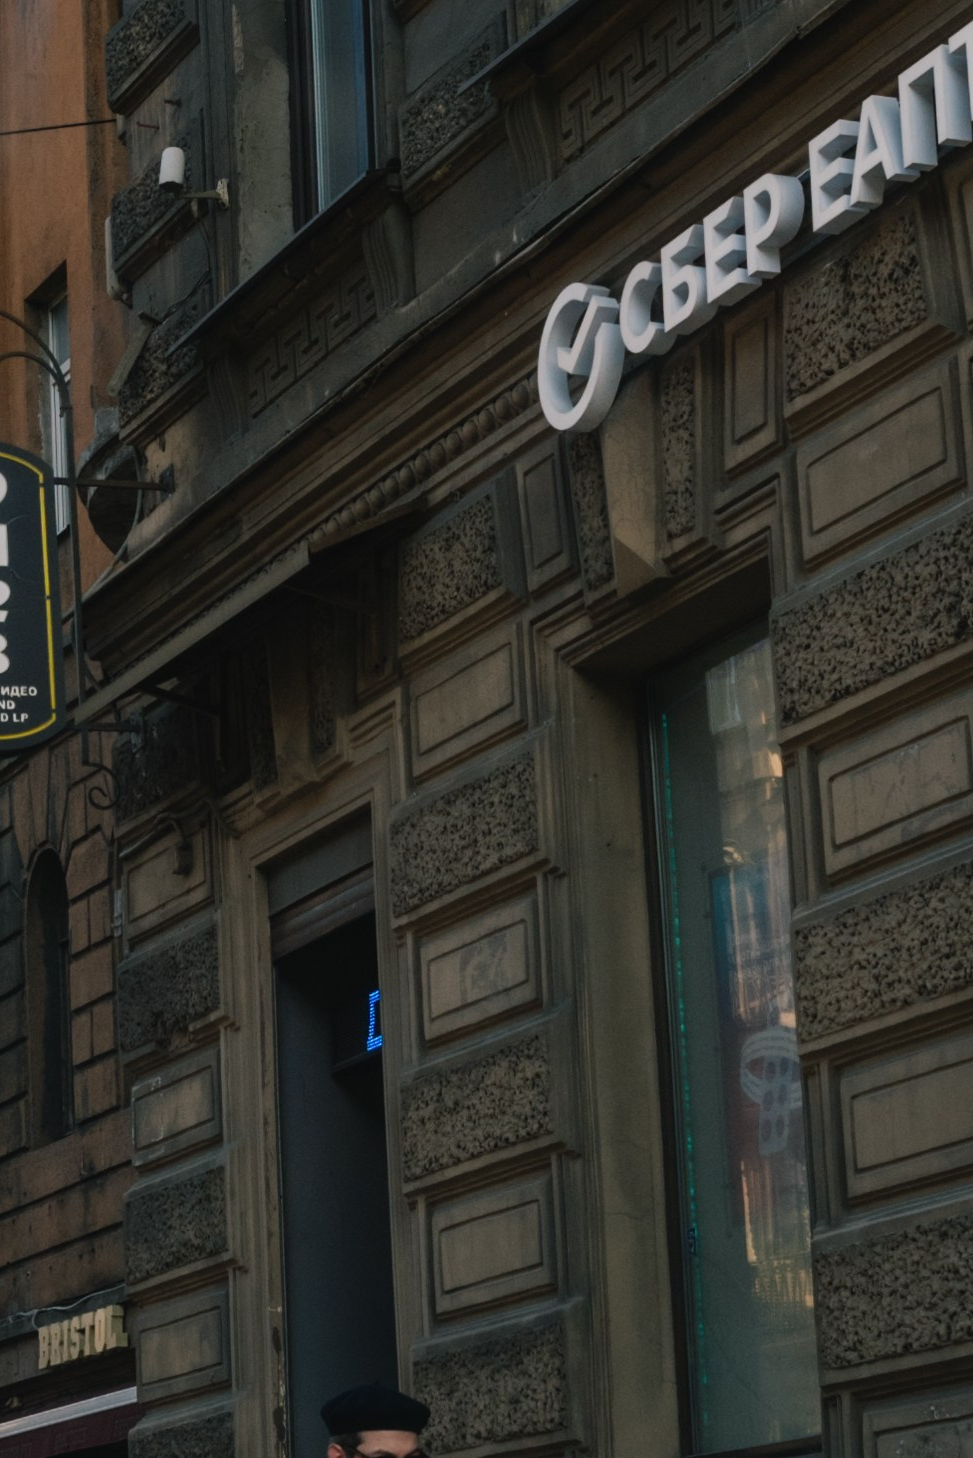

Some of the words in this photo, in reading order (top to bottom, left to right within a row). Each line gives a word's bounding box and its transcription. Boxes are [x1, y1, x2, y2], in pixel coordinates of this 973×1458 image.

[619, 173, 804, 356] СБЕР
[12, 713, 29, 723] LP
[38, 1304, 129, 1370] BRISTOL
